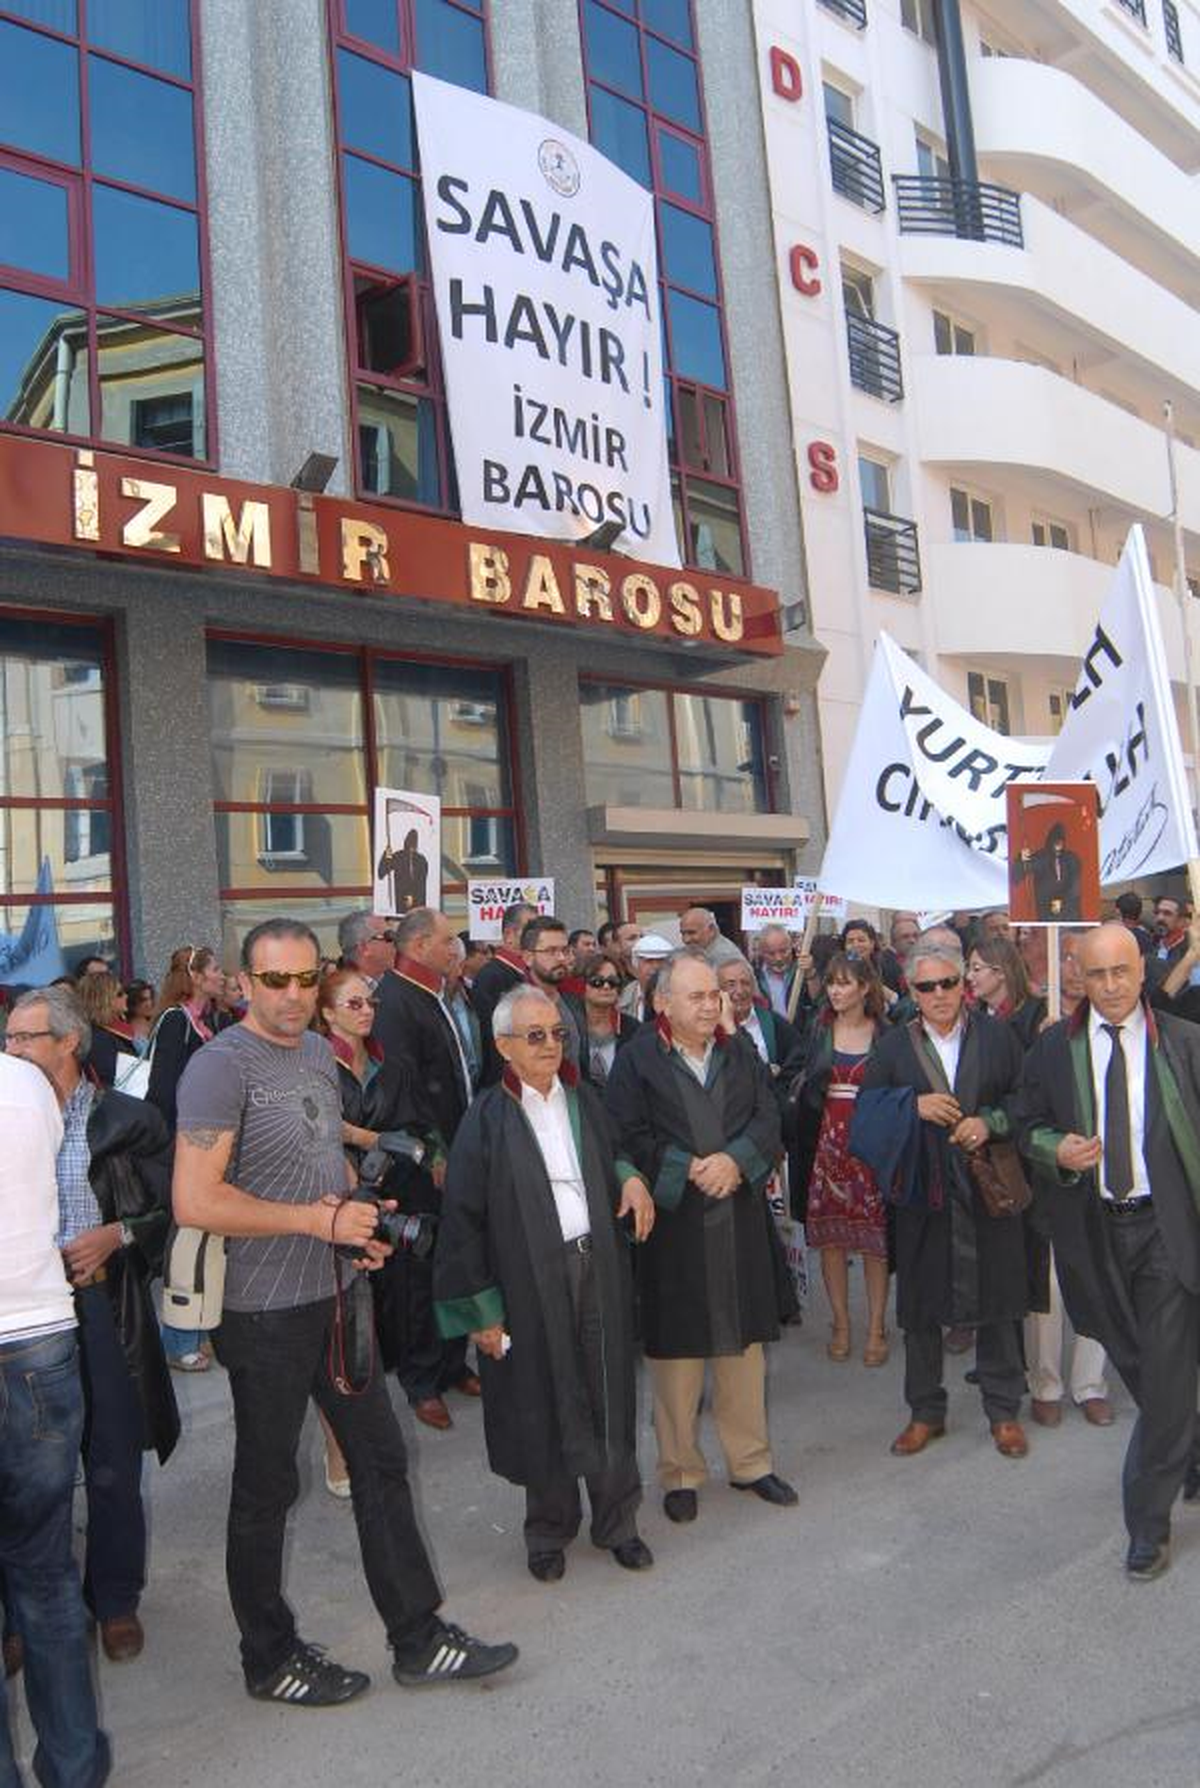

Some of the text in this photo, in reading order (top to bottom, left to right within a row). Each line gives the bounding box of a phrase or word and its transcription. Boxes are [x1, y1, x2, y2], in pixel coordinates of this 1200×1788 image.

[436, 174, 652, 322] SAVAŞA
[482, 458, 651, 541] BAROSU
[469, 542, 744, 643] BAROSU
